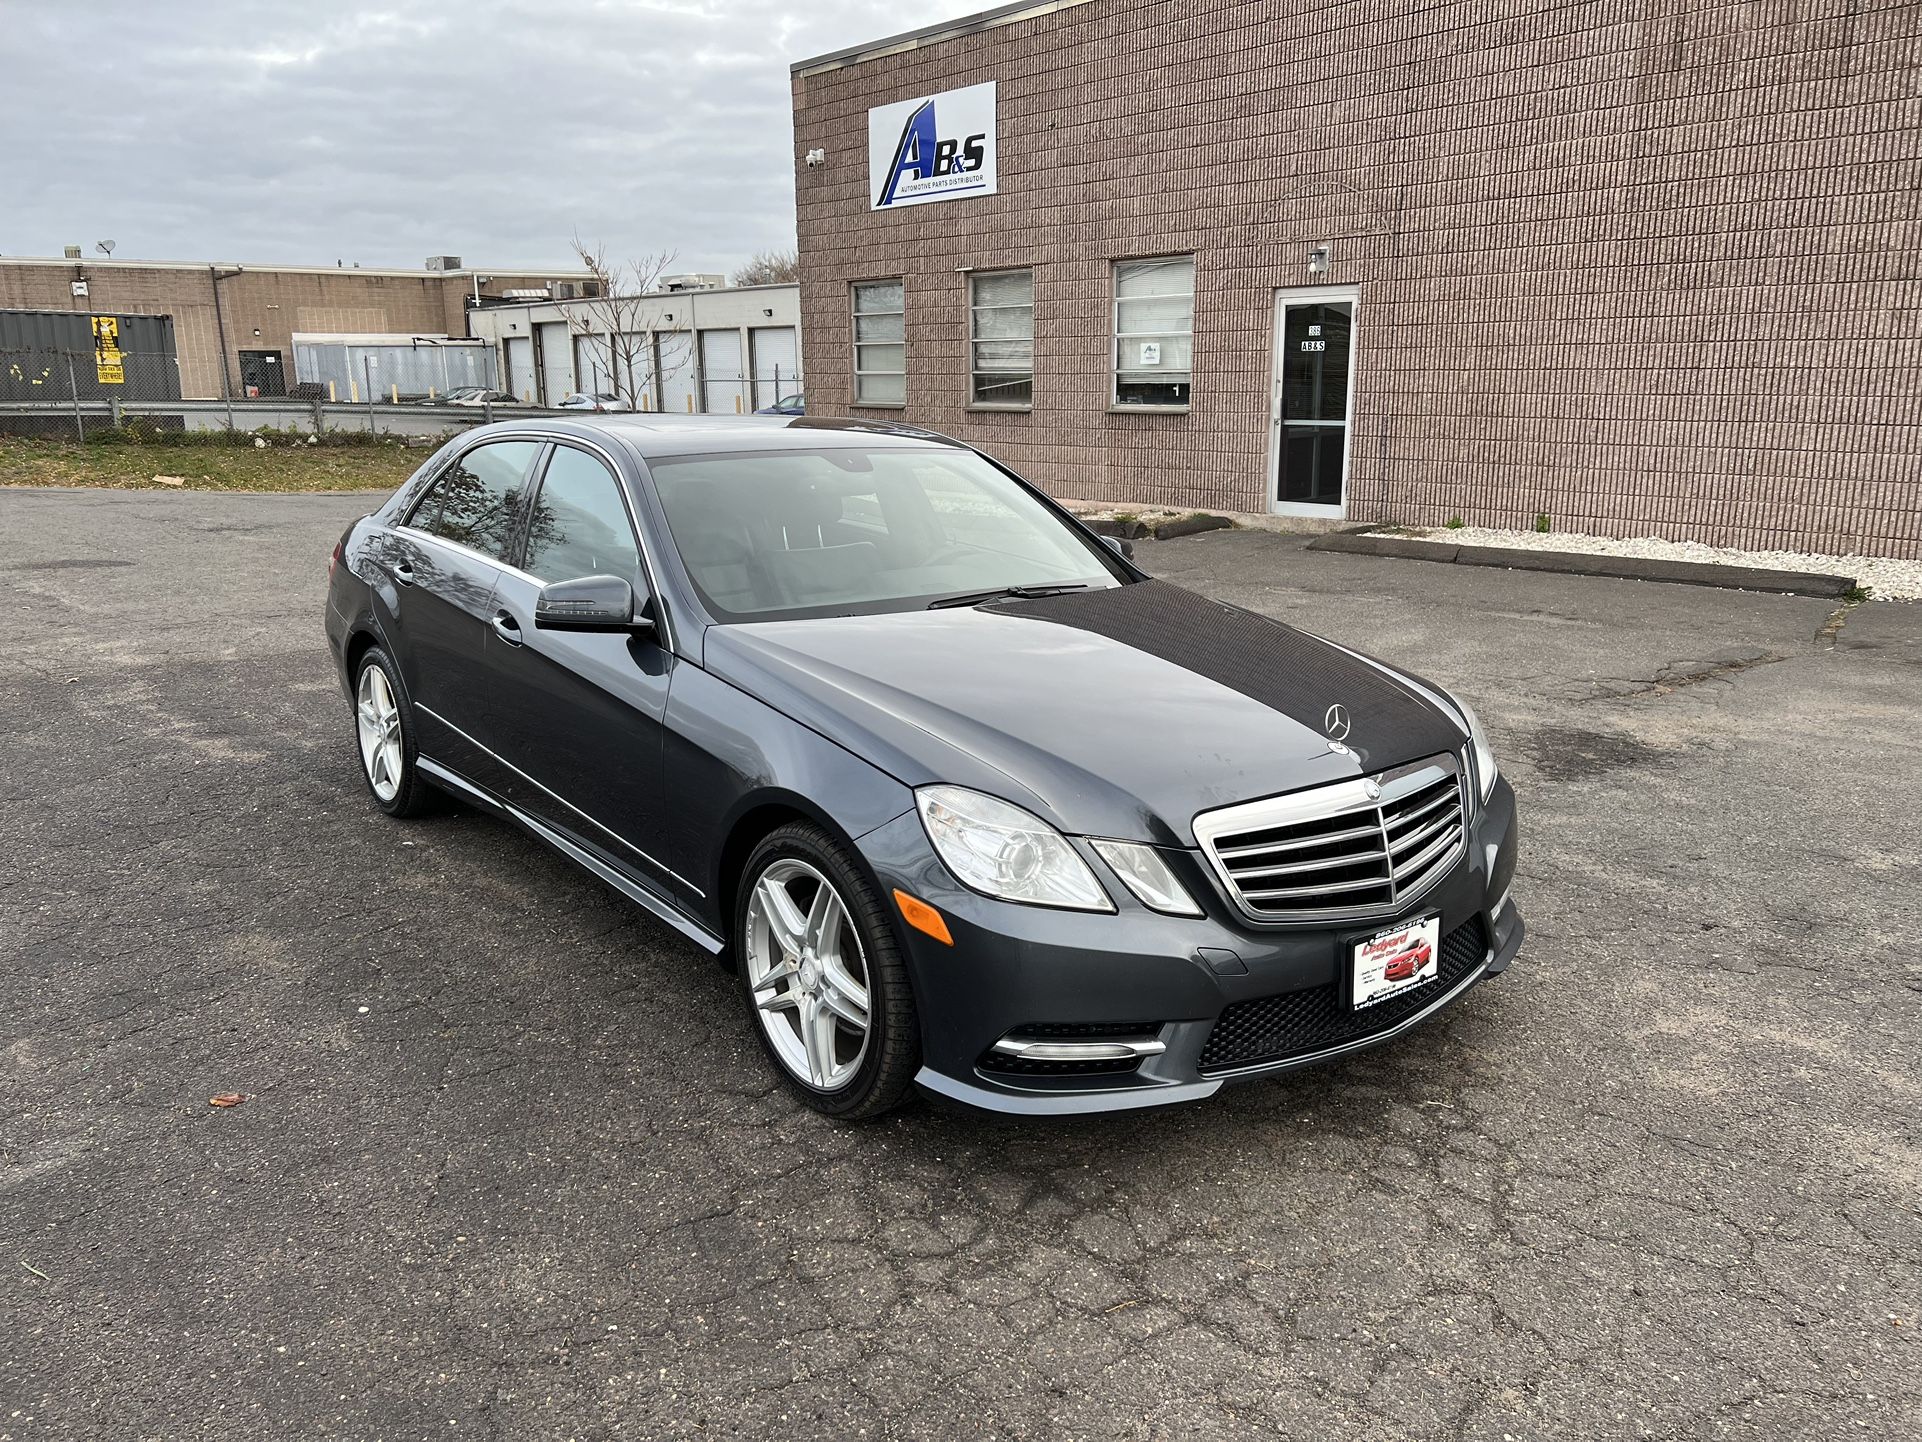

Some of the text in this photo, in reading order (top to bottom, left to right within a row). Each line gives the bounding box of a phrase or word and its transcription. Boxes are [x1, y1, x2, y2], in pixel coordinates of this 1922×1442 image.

[901, 174, 984, 192] AUTOMOTIVE PARTS DISTRIBUTOR
[1302, 341, 1324, 350] AB&S
[1362, 931, 1409, 957] Ledyard
[1354, 975, 1439, 1011] LedyardAutoSales.com
